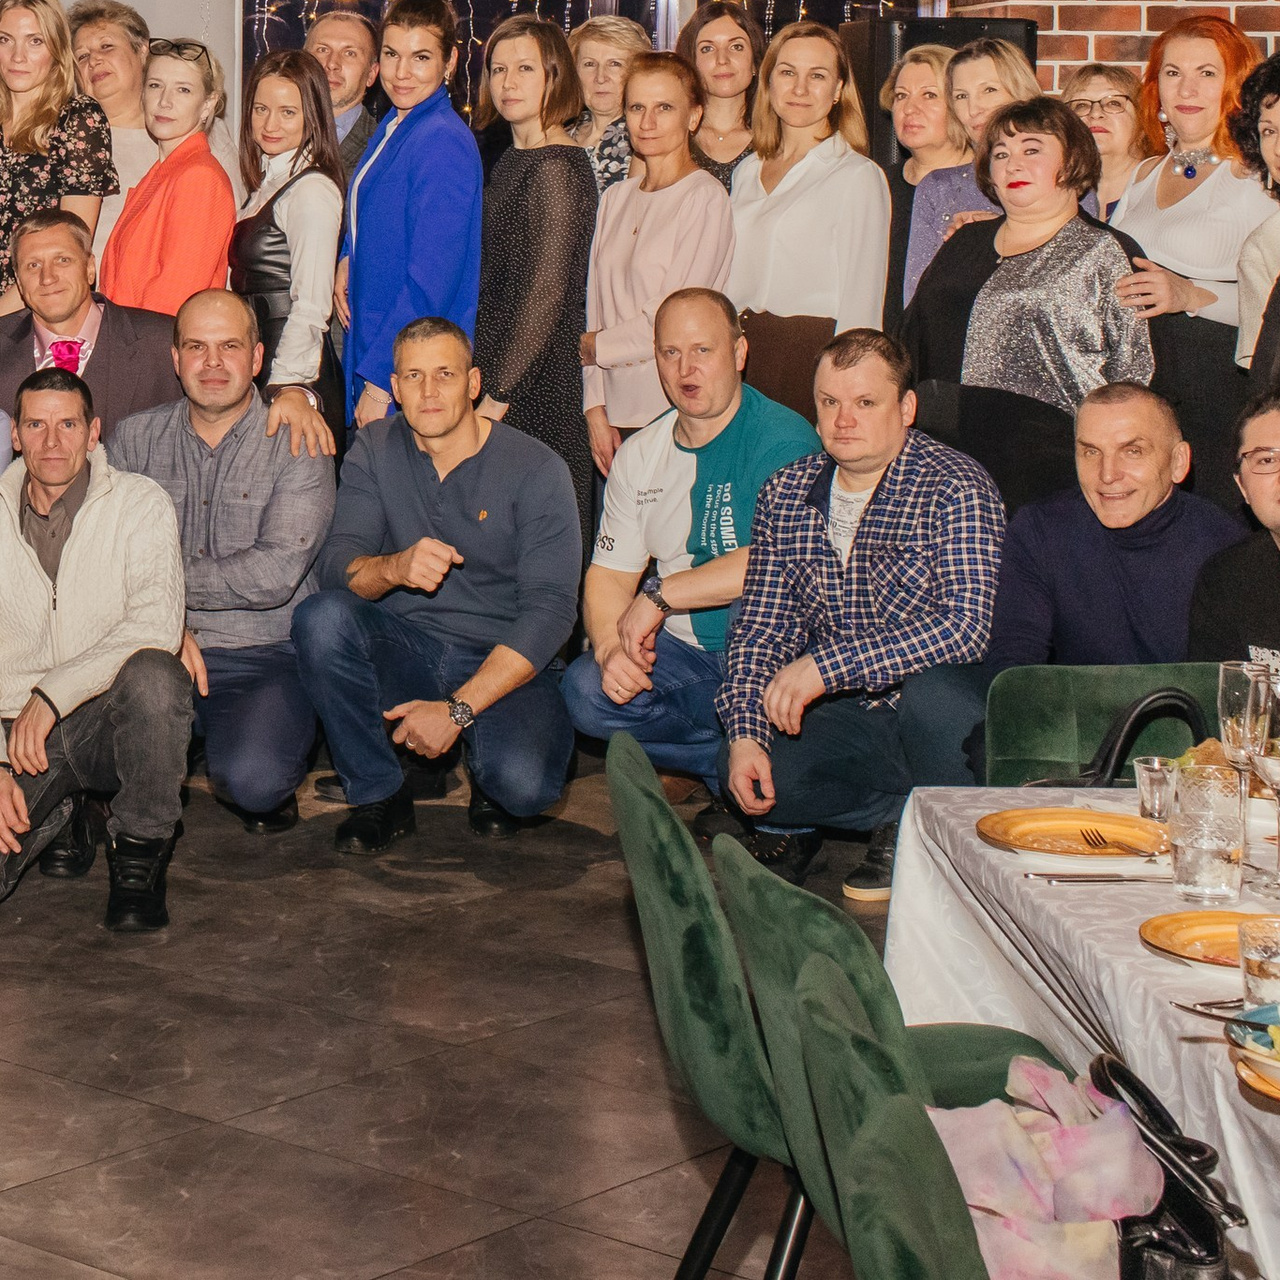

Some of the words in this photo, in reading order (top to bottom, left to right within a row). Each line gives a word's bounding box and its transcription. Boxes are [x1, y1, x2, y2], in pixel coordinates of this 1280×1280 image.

[705, 494, 713, 509] the
[714, 484, 724, 509] Focus
[722, 482, 732, 503] DO
[712, 510, 718, 522] on
[700, 510, 710, 547] moment
[709, 522, 718, 538] the
